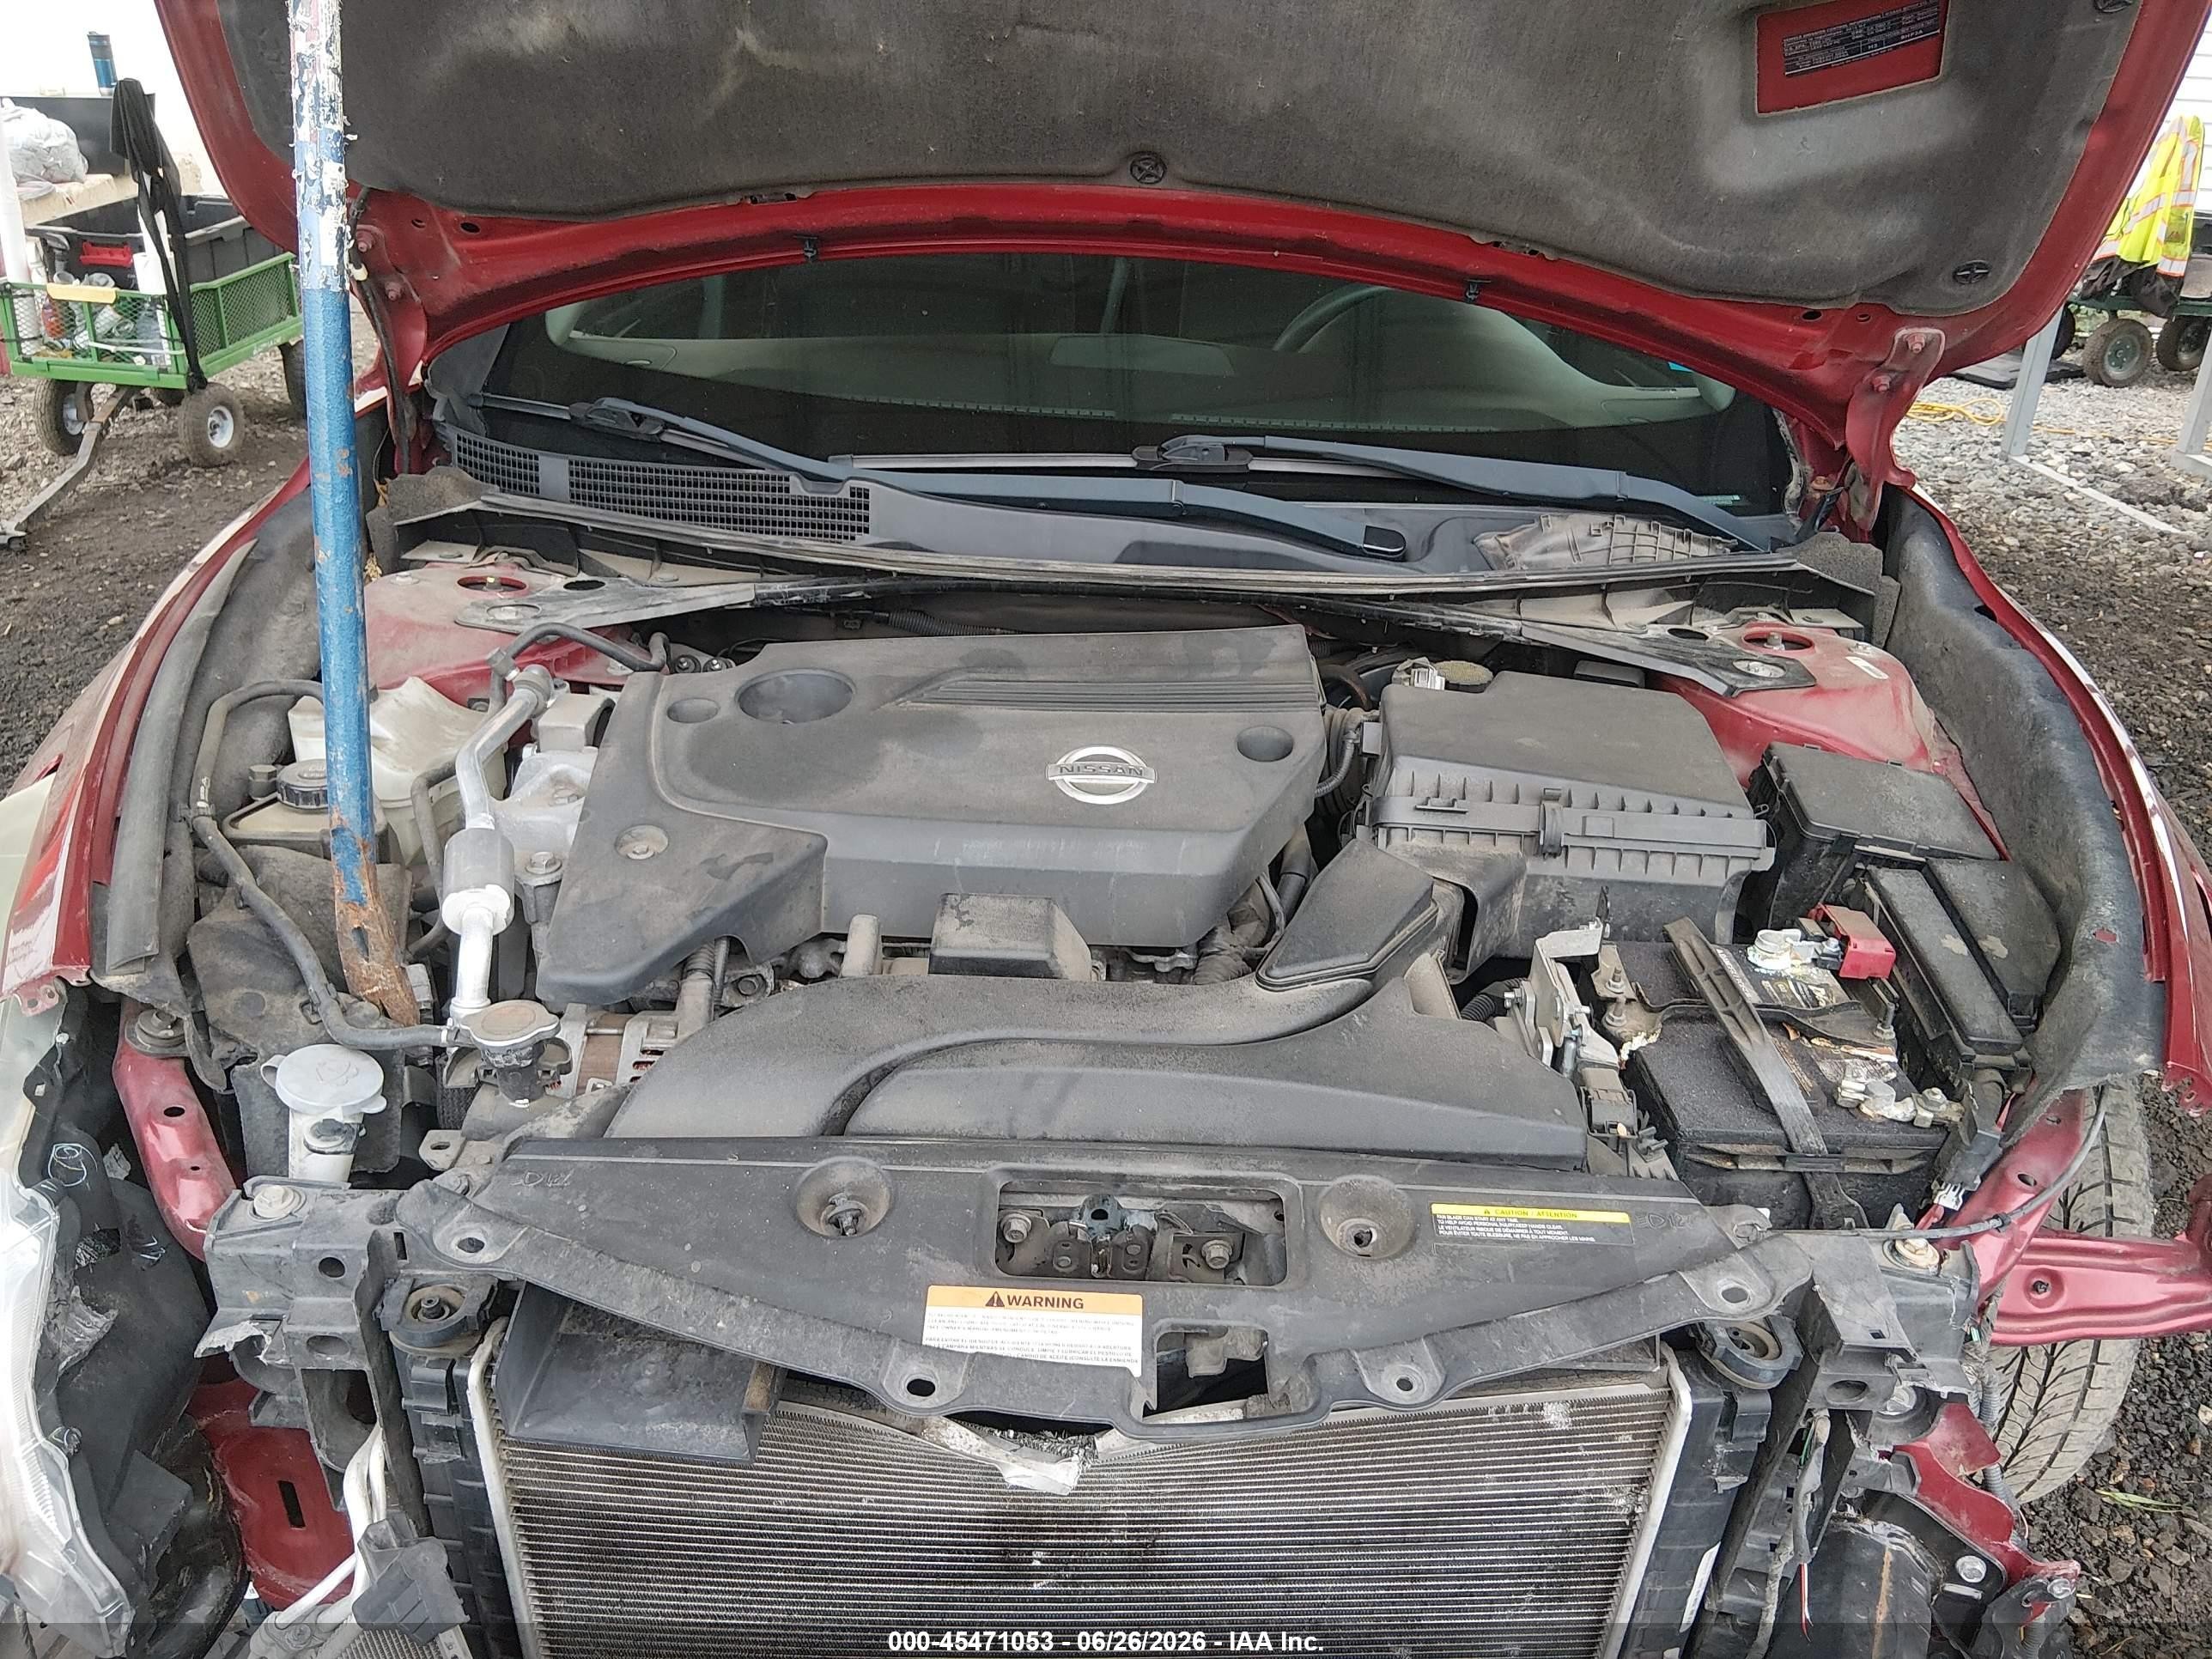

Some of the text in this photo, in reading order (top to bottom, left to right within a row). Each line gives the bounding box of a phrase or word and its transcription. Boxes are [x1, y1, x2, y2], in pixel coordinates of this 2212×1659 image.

[1059, 764, 1143, 776] NISSAN
[1494, 1208, 1528, 1217] CAUTION
[1536, 1210, 1577, 1218] ATTENTION
[1006, 1295, 1085, 1310] WARNING
